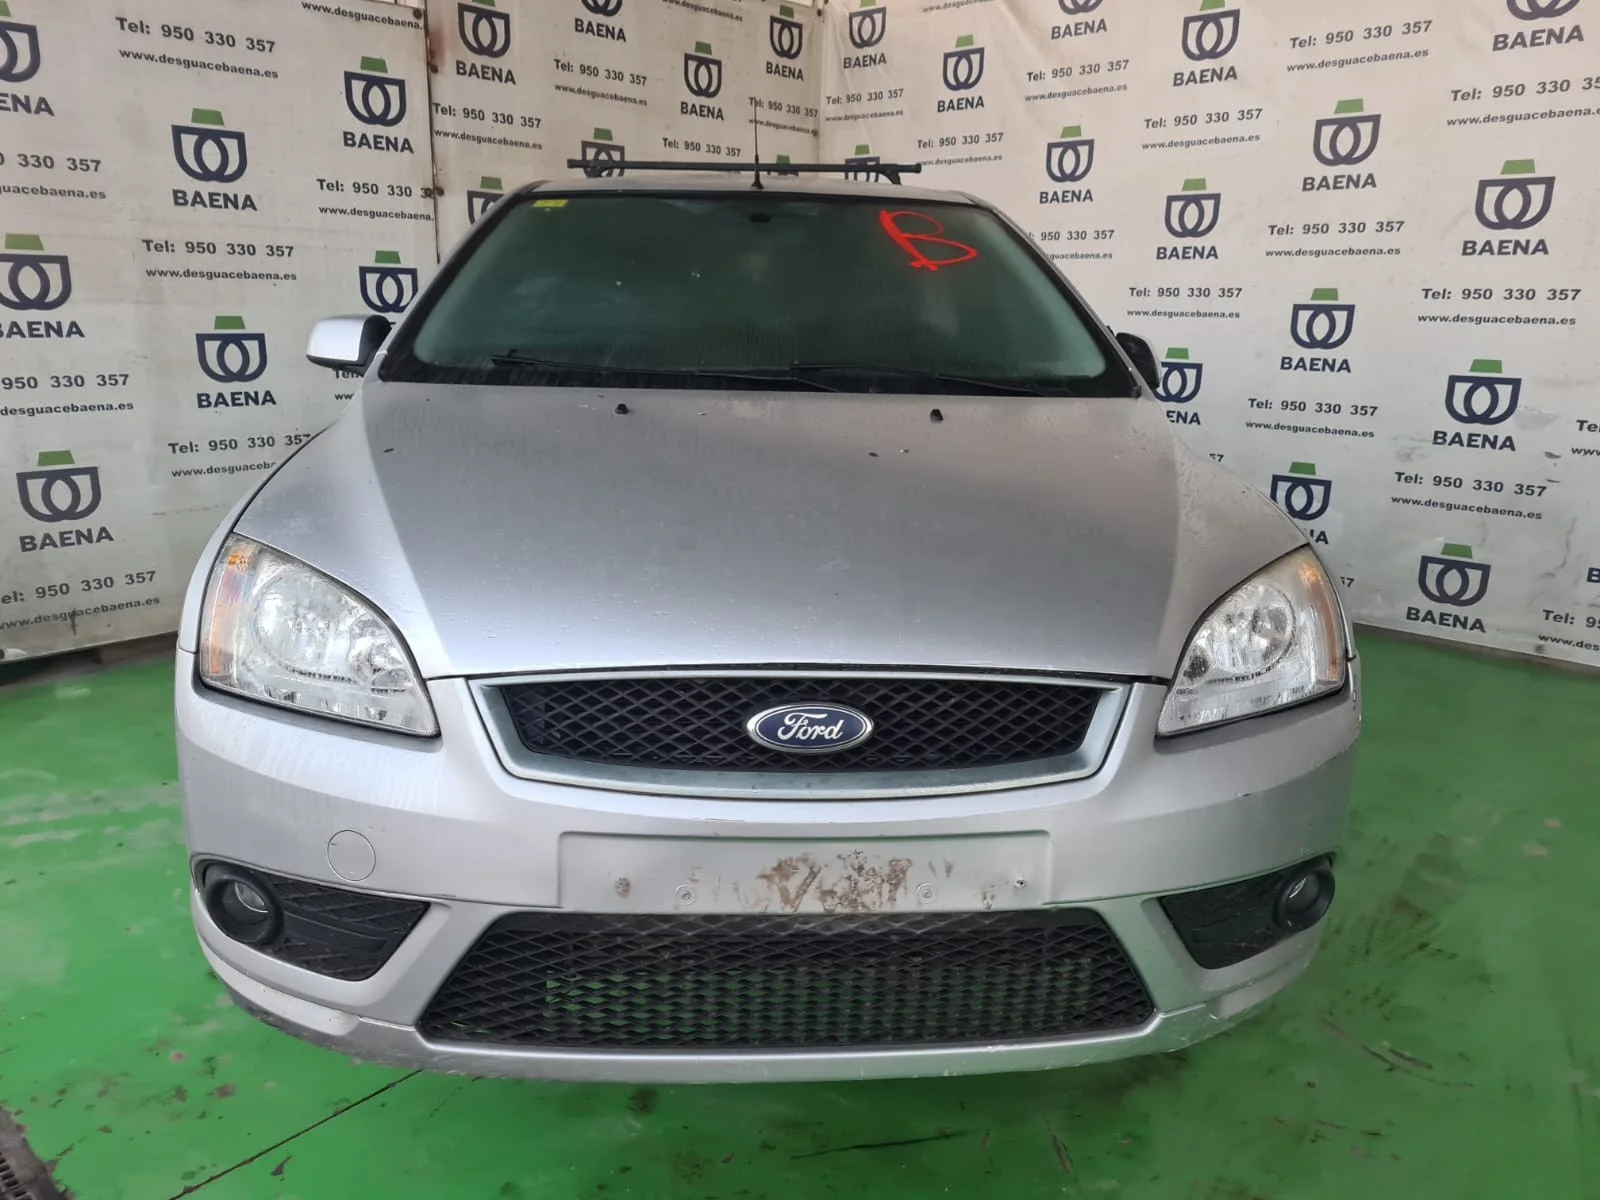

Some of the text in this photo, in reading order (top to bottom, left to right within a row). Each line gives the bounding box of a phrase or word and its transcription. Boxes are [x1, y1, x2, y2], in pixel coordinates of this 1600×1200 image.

[301, 1, 423, 30] www.desguacebaena.
[116, 17, 275, 53] Tel: 950 330 357
[575, 18, 626, 42] BAENA
[1051, 18, 1107, 40] BAENA
[1290, 20, 1432, 48] Tel: 950 330 357
[1492, 25, 1584, 51] BAENA
[119, 48, 279, 79] www.desguacebaena.es
[843, 53, 886, 69] BAENA
[1287, 50, 1428, 71] www.desguacebaena.es
[456, 60, 516, 85] BAENA
[554, 59, 647, 86] Tel: 950 330 357
[766, 61, 803, 81] BAENA
[1027, 59, 1129, 81] Tel: 950 330 357
[1173, 66, 1237, 86] BAENA
[826, 88, 904, 104] Tel: 950 330 357
[1451, 76, 1600, 101] Tel: 950 330 35
[0, 92, 55, 117] ENA
[681, 101, 724, 120] BAENA
[768, 100, 782, 111] 950
[786, 104, 800, 115] 330
[804, 108, 818, 118] 357
[937, 96, 984, 112] BAENA
[432, 103, 541, 128] Tel: 950 330 357
[1144, 109, 1262, 128] Tel: 950 330 357
[1447, 107, 1600, 126] www.desguacebaena.e
[343, 131, 414, 153] BAENA
[662, 138, 741, 157] Tel: 950 330 357
[918, 132, 1004, 148] Tel: 950 330 357
[1142, 135, 1260, 149] www.desguacebaena.es
[18, 154, 54, 169] 330
[67, 158, 101, 172] 357
[316, 179, 344, 192] Tel:
[353, 182, 378, 194] 950
[387, 185, 412, 197] 330
[1302, 173, 1376, 192] BAENA
[0, 185, 106, 199] uacebaena.es
[173, 189, 257, 211] BAENA
[1040, 189, 1093, 204] BAENA
[318, 205, 434, 222] www.desguacebaena.
[1041, 232, 1060, 241] 950
[1067, 231, 1087, 240] 330
[1094, 230, 1115, 240] 357
[1268, 221, 1404, 235] Tel: 950 330 357
[142, 239, 294, 257] Tel: 950 330 357
[1156, 246, 1218, 260] BAENA
[1266, 248, 1400, 258] www.desguacebaena.es
[1462, 239, 1549, 256] BAENA
[146, 269, 296, 280] www.desguacebaena.es
[1129, 288, 1242, 298] Tel: 950 330 357
[1422, 289, 1581, 300] Tel: 950 330 357
[1127, 310, 1240, 318] www.desguacebaena.es
[1418, 314, 1576, 325] www.desguacebaena.es
[0, 321, 85, 338] AENA
[1280, 356, 1351, 373] BAENA
[1, 374, 129, 390] 950 330 357
[197, 390, 276, 408] BAENA
[1248, 398, 1378, 416] Tel: 950 330 357
[0, 402, 134, 416] desguacebaena.es
[1166, 410, 1201, 425] ENA
[1246, 422, 1374, 437] www.desguacebaena.es
[168, 442, 199, 454] Tel:
[209, 439, 238, 451] 950
[248, 436, 275, 448] 330
[1432, 431, 1515, 451] BAENA
[1395, 472, 1547, 496] Tel: 950 330 357
[1392, 497, 1542, 519] www.desguacebaena.es
[20, 527, 114, 552] BAENA
[1, 571, 155, 604] el: 950 330 357
[1406, 607, 1486, 633] BAENA
[1543, 609, 1574, 624] Tel:
[777, 712, 845, 741] Ford
